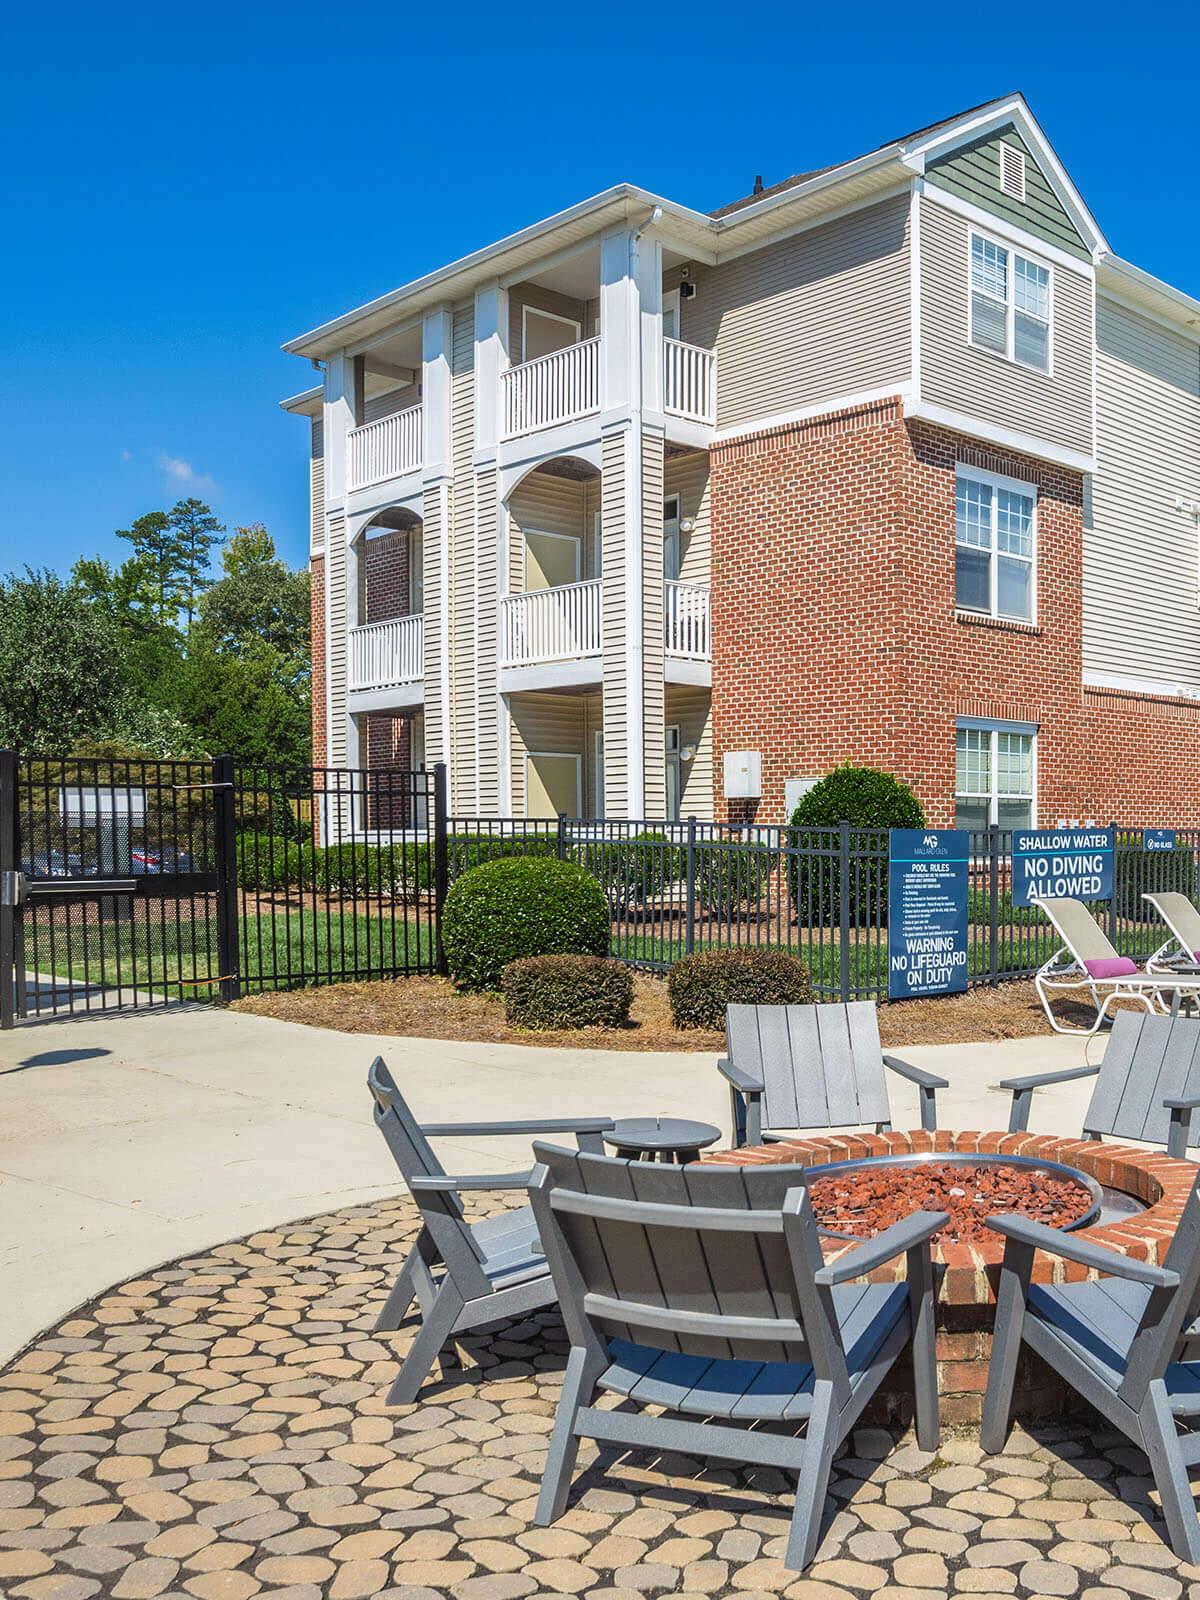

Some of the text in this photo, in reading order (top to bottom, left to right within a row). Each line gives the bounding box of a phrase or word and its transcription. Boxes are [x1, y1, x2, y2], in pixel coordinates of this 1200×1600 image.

[1019, 835, 1107, 850] SHALLOW WATER
[912, 864, 950, 872] POOL RULES
[1024, 855, 1103, 877] NO DIVING
[1026, 876, 1101, 899] ALLOWED
[906, 937, 954, 954] WARNING
[891, 951, 966, 971] NO LIFEGUARD
[907, 967, 953, 985] ON DUTY
